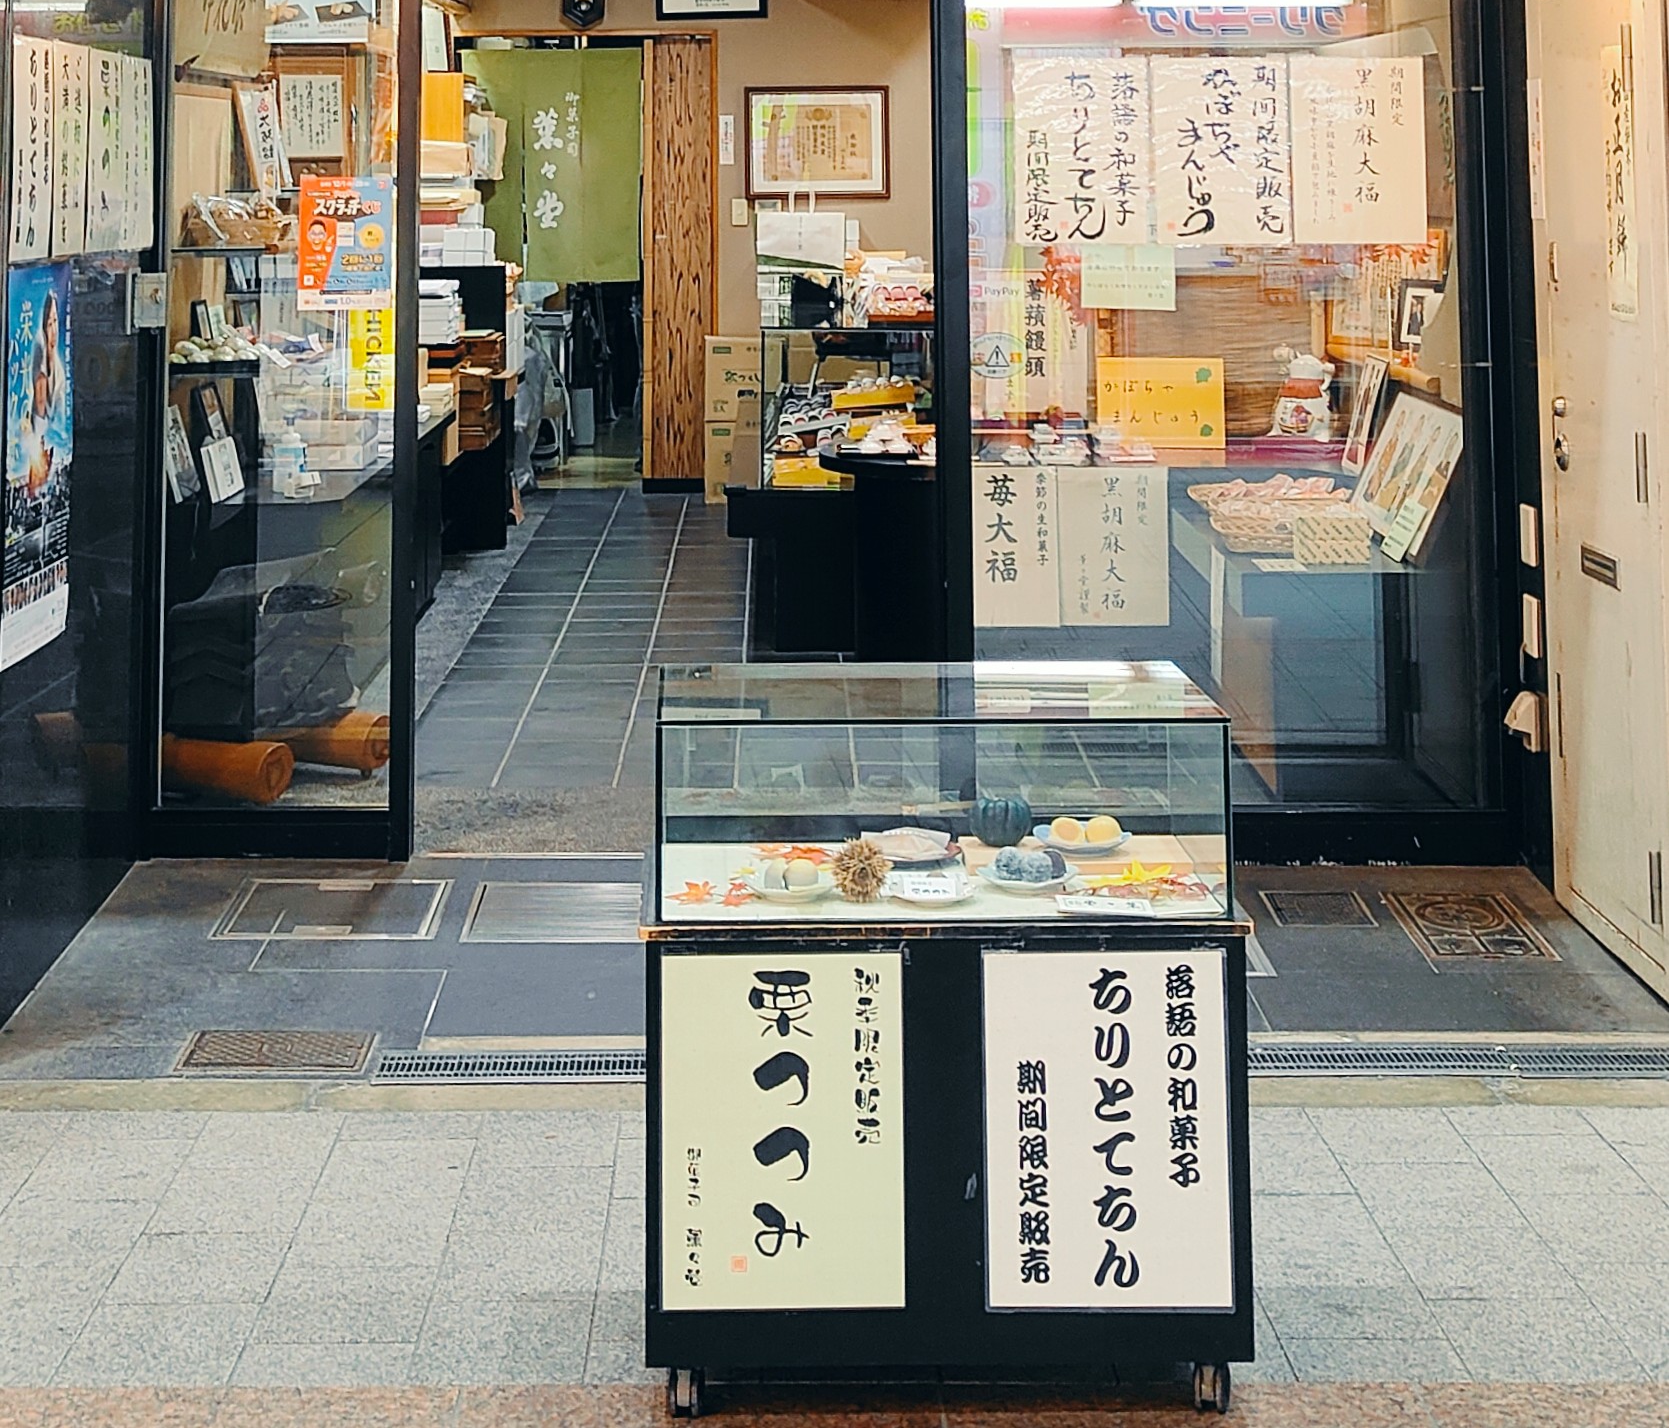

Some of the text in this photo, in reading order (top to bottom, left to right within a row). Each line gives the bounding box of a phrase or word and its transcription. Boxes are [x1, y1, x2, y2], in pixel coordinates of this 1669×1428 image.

[1103, 72, 1140, 227] 落語の和菓子
[1252, 65, 1284, 235] 期間限定販売
[1352, 68, 1381, 204] 黒胡麻大福
[1388, 65, 1404, 127] 期間限定
[313, 198, 382, 216] スクラッチくじ
[984, 286, 1021, 297] PayPay
[1103, 380, 1175, 395] かぼちゃ
[1112, 409, 1200, 425] まんじゅう
[983, 473, 1018, 584] 苺大福
[1035, 472, 1049, 566] 季節の生和菓子
[1100, 476, 1126, 610] 黒胡麻大福
[1136, 474, 1148, 526] 期間限定
[748, 969, 814, 1258] 栗つつみ
[1088, 967, 1140, 1289] ちりとてちん
[1165, 964, 1201, 1188] 落語の和菓子
[1017, 1059, 1051, 1285] 期間限定販売
